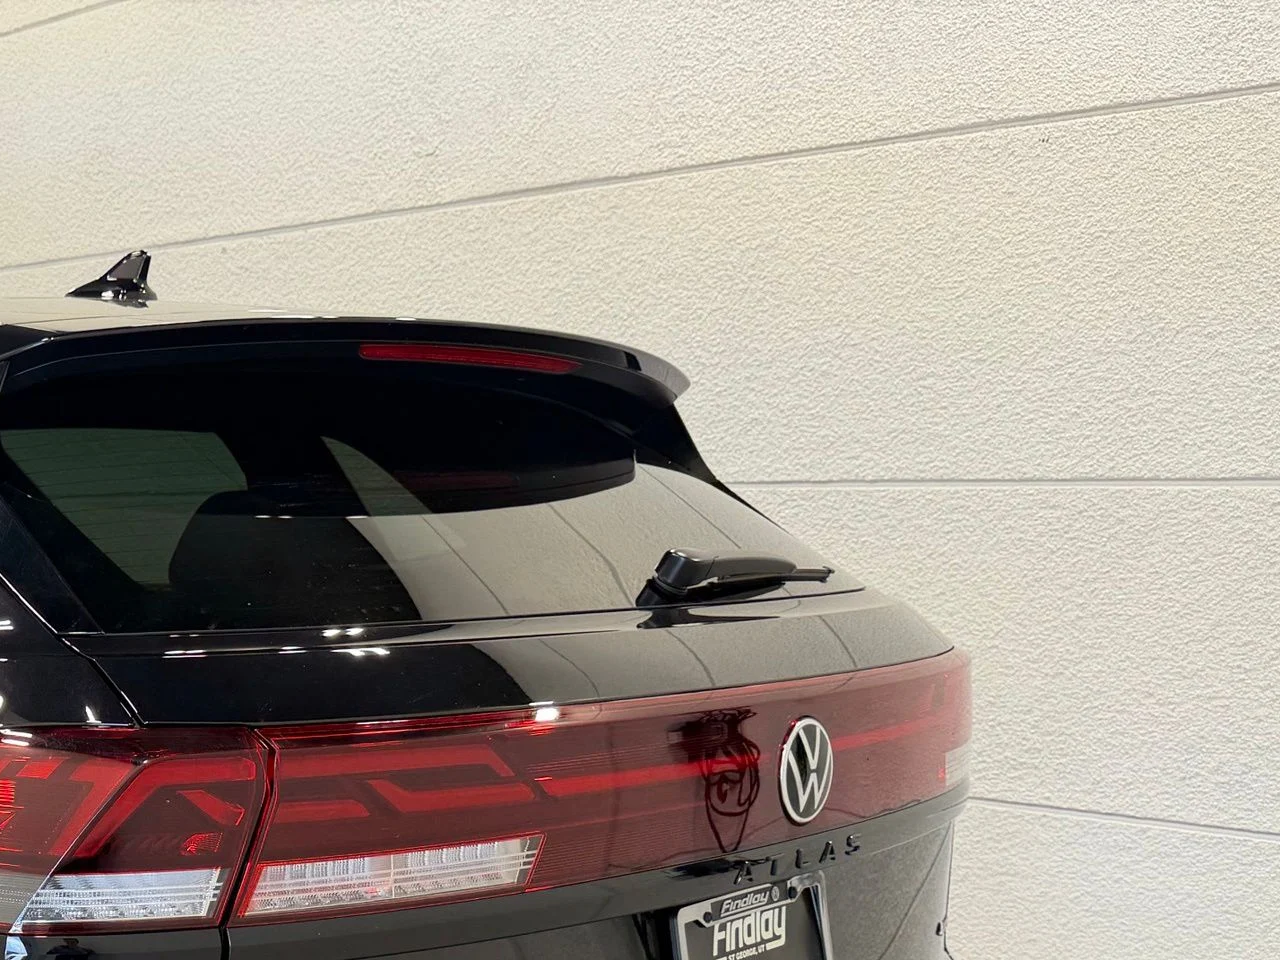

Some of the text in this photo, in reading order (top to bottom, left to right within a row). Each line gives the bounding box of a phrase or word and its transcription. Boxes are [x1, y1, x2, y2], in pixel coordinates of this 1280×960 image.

[734, 834, 862, 885] ATLAS
[721, 890, 770, 917] Findlay
[713, 905, 786, 957] Findlay
[757, 944, 765, 953] UT
